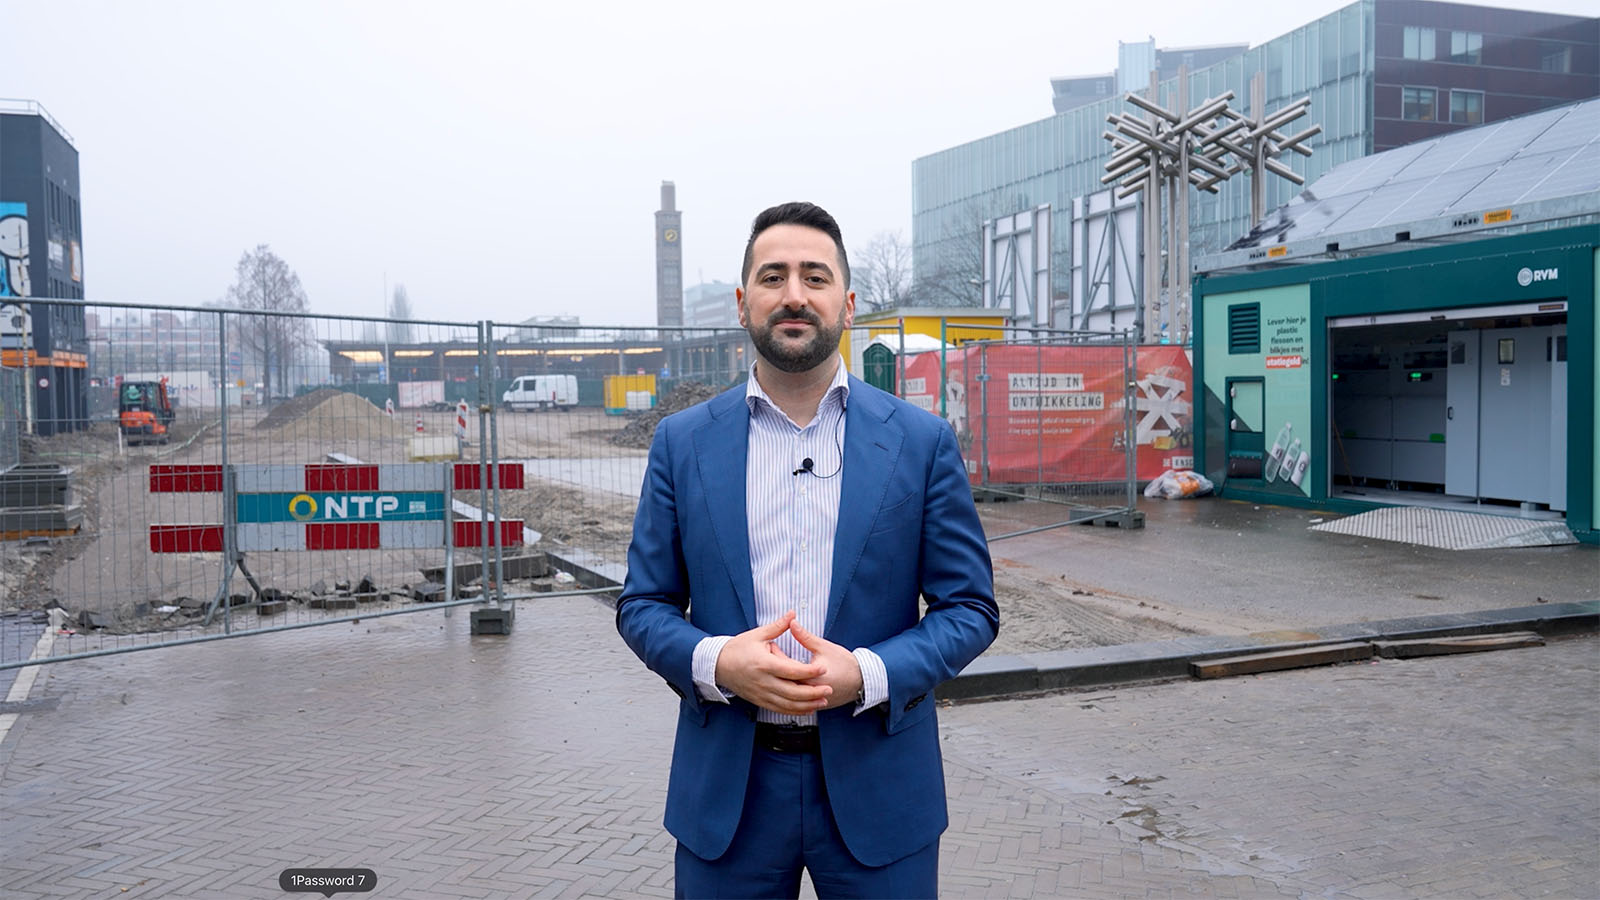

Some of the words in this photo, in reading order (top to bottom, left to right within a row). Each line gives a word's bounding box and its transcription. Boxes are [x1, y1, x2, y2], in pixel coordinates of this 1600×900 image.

[1534, 268, 1558, 281] RVM
[1300, 316, 1306, 325] je
[1277, 327, 1298, 336] plastic
[1270, 346, 1290, 355] blikjes
[1267, 357, 1300, 367] statiegeld
[1012, 377, 1057, 388] ALTIJD
[1066, 376, 1079, 387] IN
[1012, 395, 1101, 408] ONTWIKKELING
[324, 496, 399, 519] NTP
